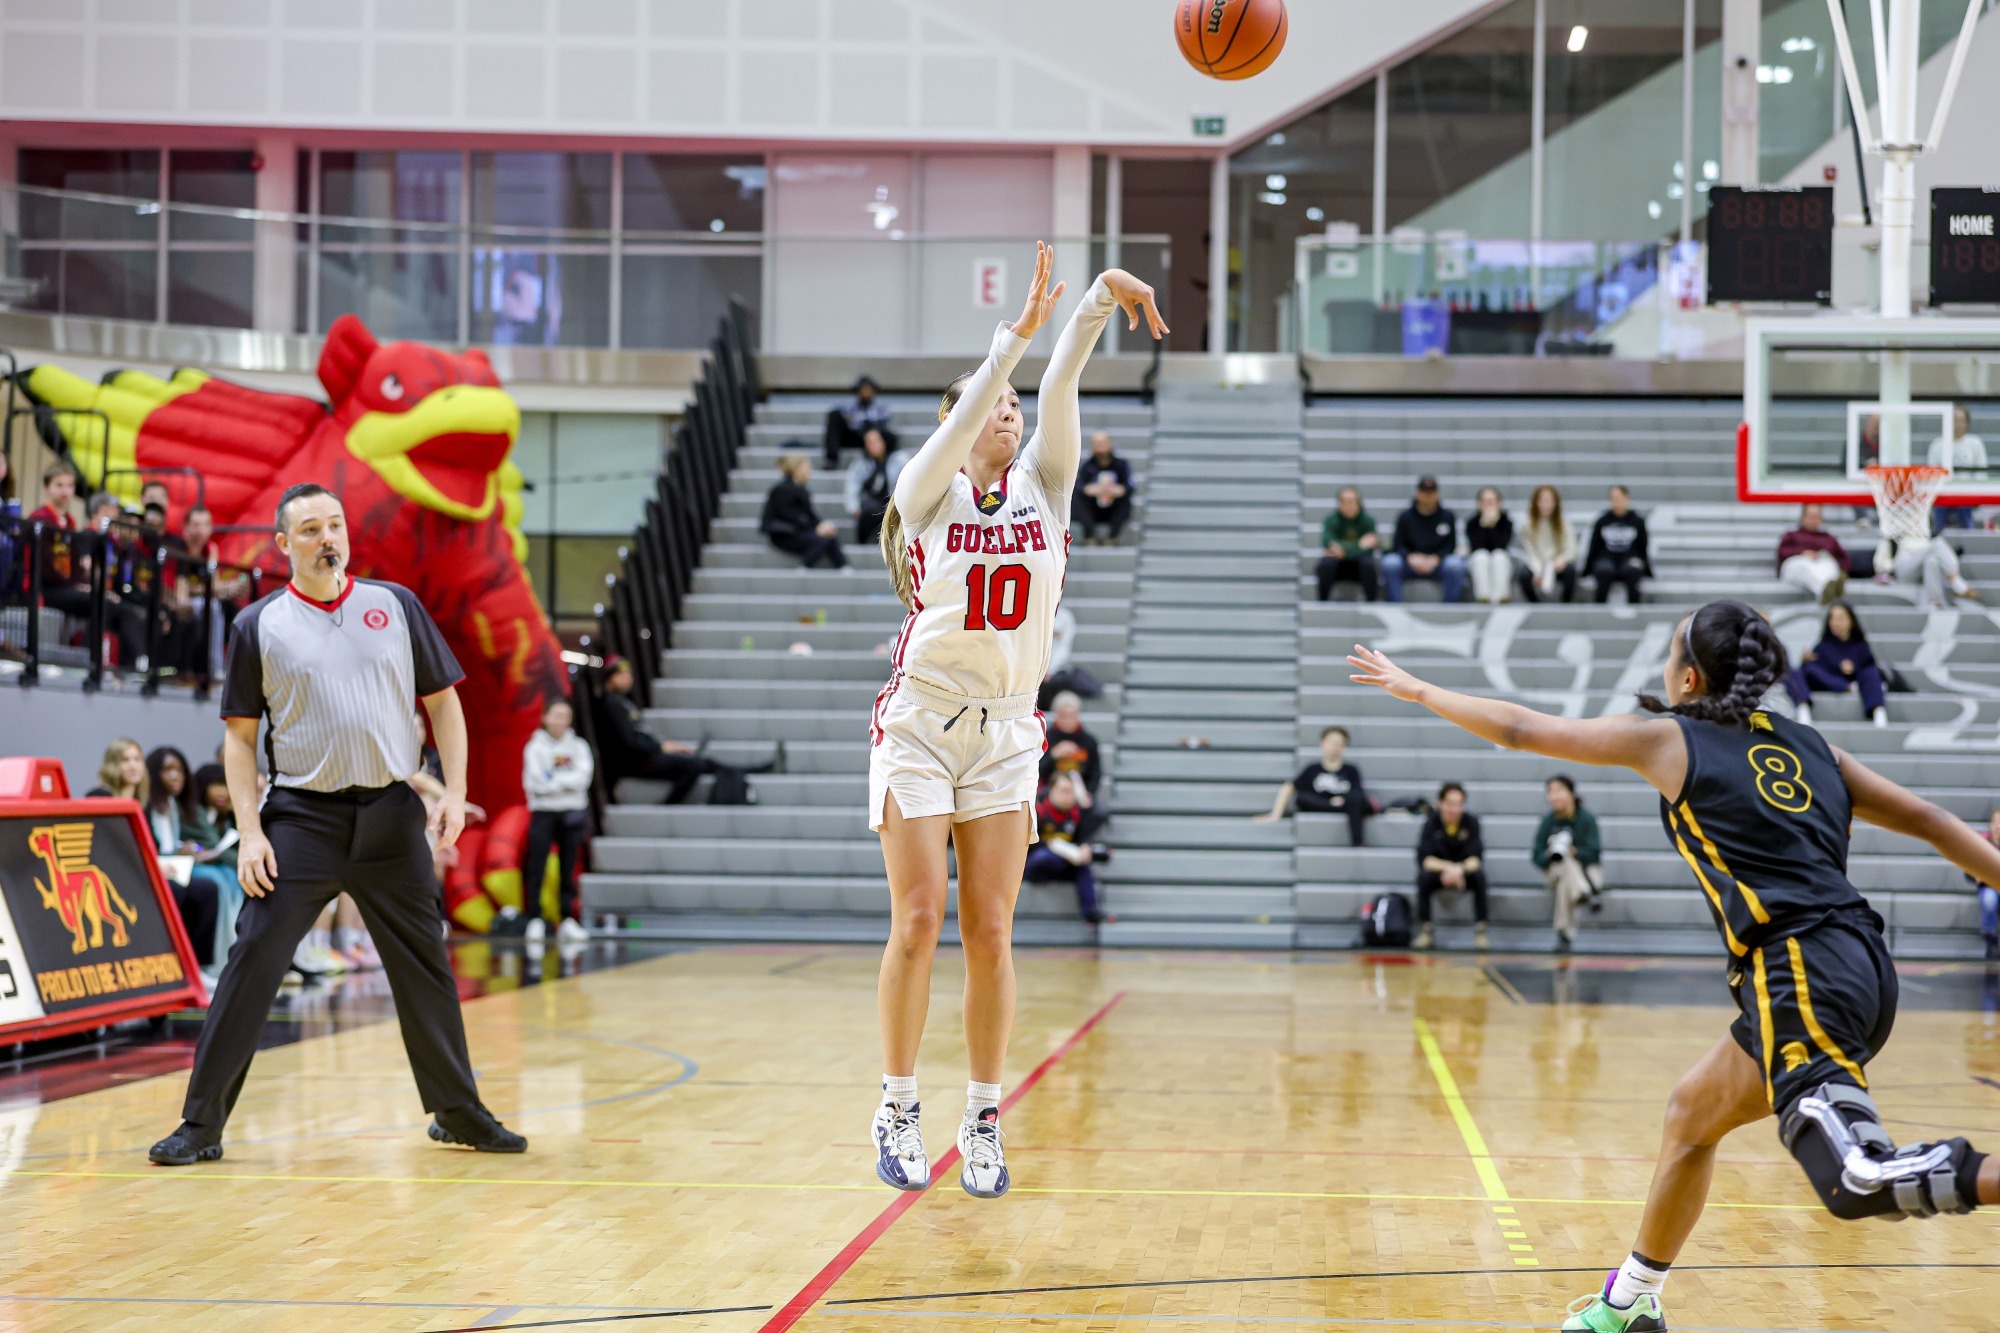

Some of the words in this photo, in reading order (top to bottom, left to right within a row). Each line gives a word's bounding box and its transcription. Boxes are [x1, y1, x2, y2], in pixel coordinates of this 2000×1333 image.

[1949, 214, 1994, 236] HOME
[982, 265, 999, 304] E
[947, 520, 1046, 554] GUELPH
[964, 563, 1031, 631] 10
[1746, 743, 1813, 814] 8
[36, 967, 86, 1003] PROUD
[80, 965, 103, 996] TO
[96, 962, 118, 993] BE
[113, 960, 130, 991] A
